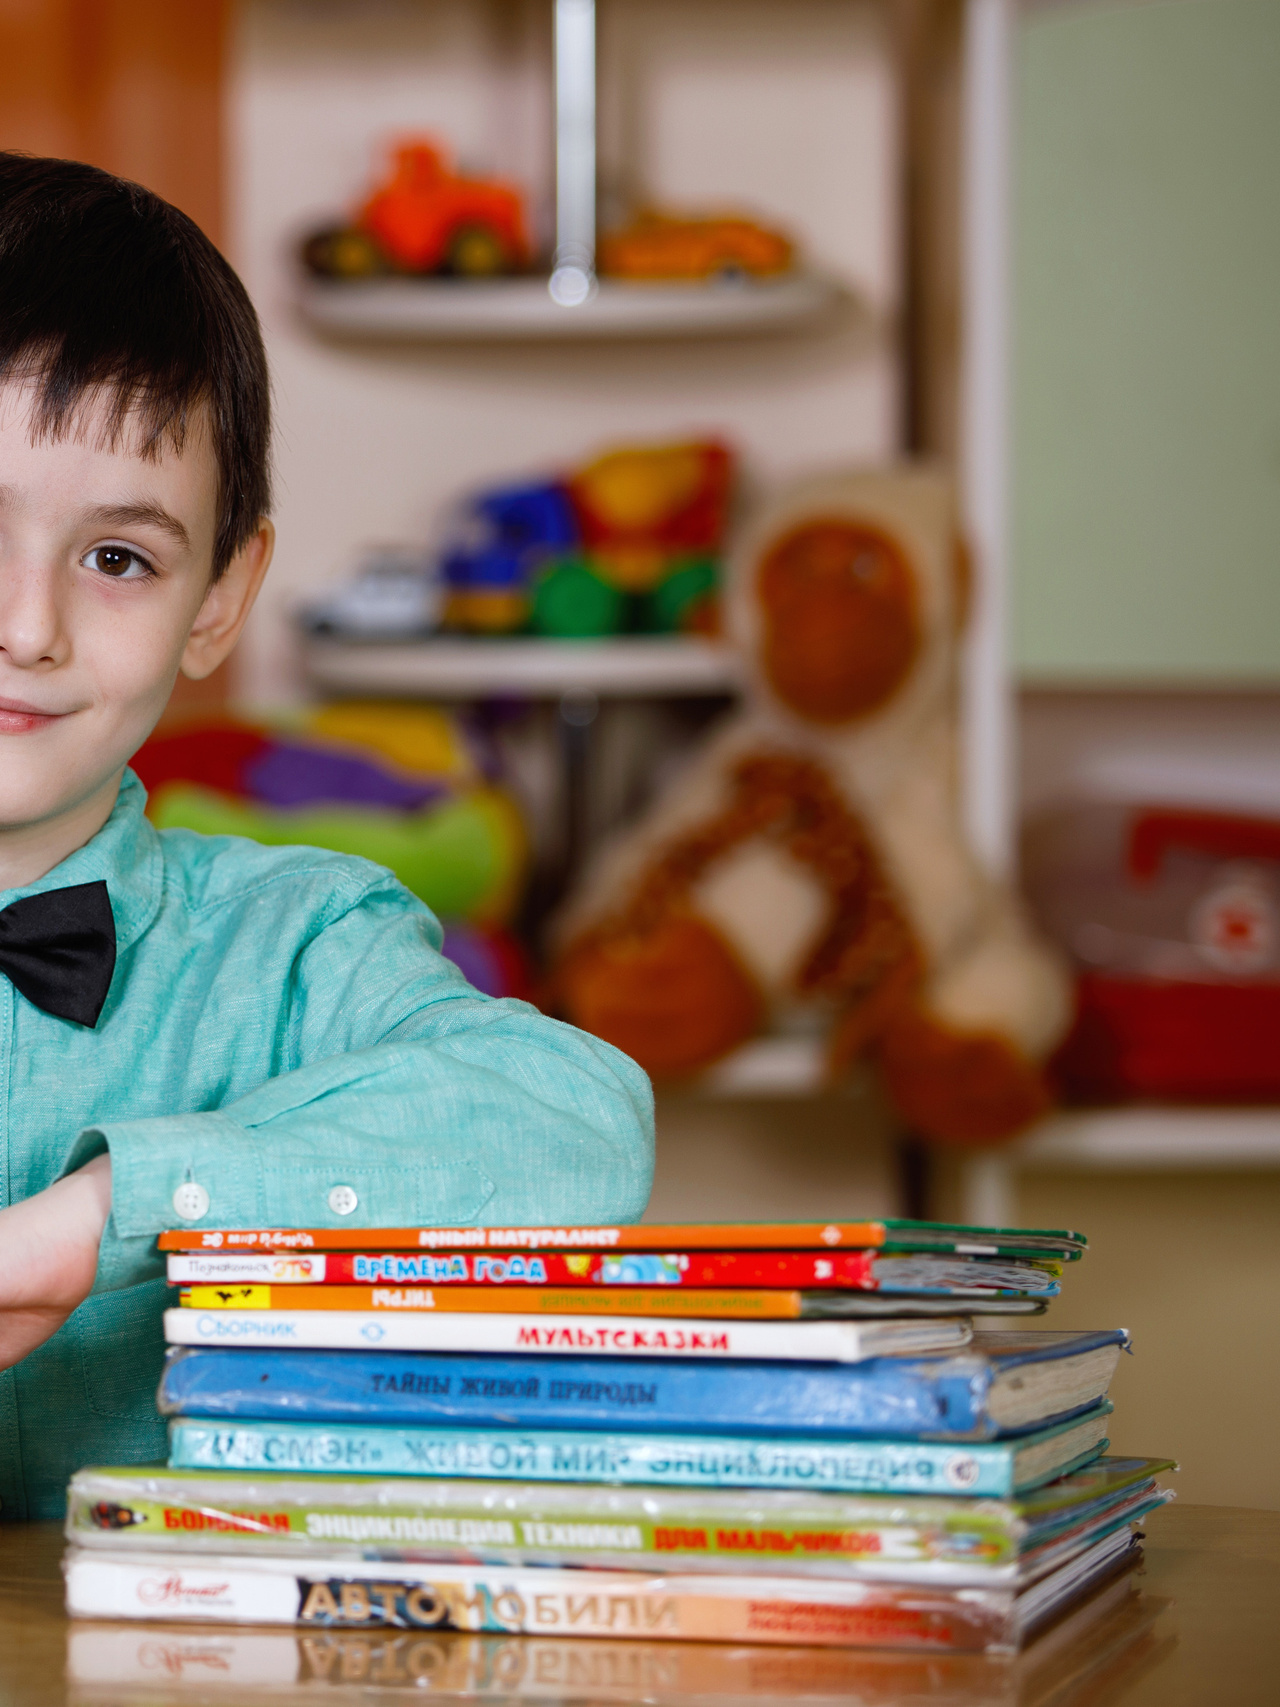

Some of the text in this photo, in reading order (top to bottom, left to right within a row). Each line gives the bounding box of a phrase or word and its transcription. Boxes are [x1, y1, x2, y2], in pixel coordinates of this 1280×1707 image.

[419, 1228, 620, 1249] ЮНЫЙ НАТУРАЛИСТ
[353, 1254, 547, 1283] ВРЕМЕНА ГОДА
[371, 1289, 436, 1308] ТИГРЫ
[517, 1325, 730, 1351] МУЛЬТСКАЗКИ
[370, 1371, 658, 1406] ТАЙНЫ ЖИВОЙ ПРИРОДЫ
[163, 1507, 883, 1556] БОЛЬШАЯ ЭНЦИКЛОПЕДИЯ ТЕХНИКИ ДЛЯ МАЛЬЧИКОВ
[301, 1581, 680, 1631] АВТОМОБИЛИ
